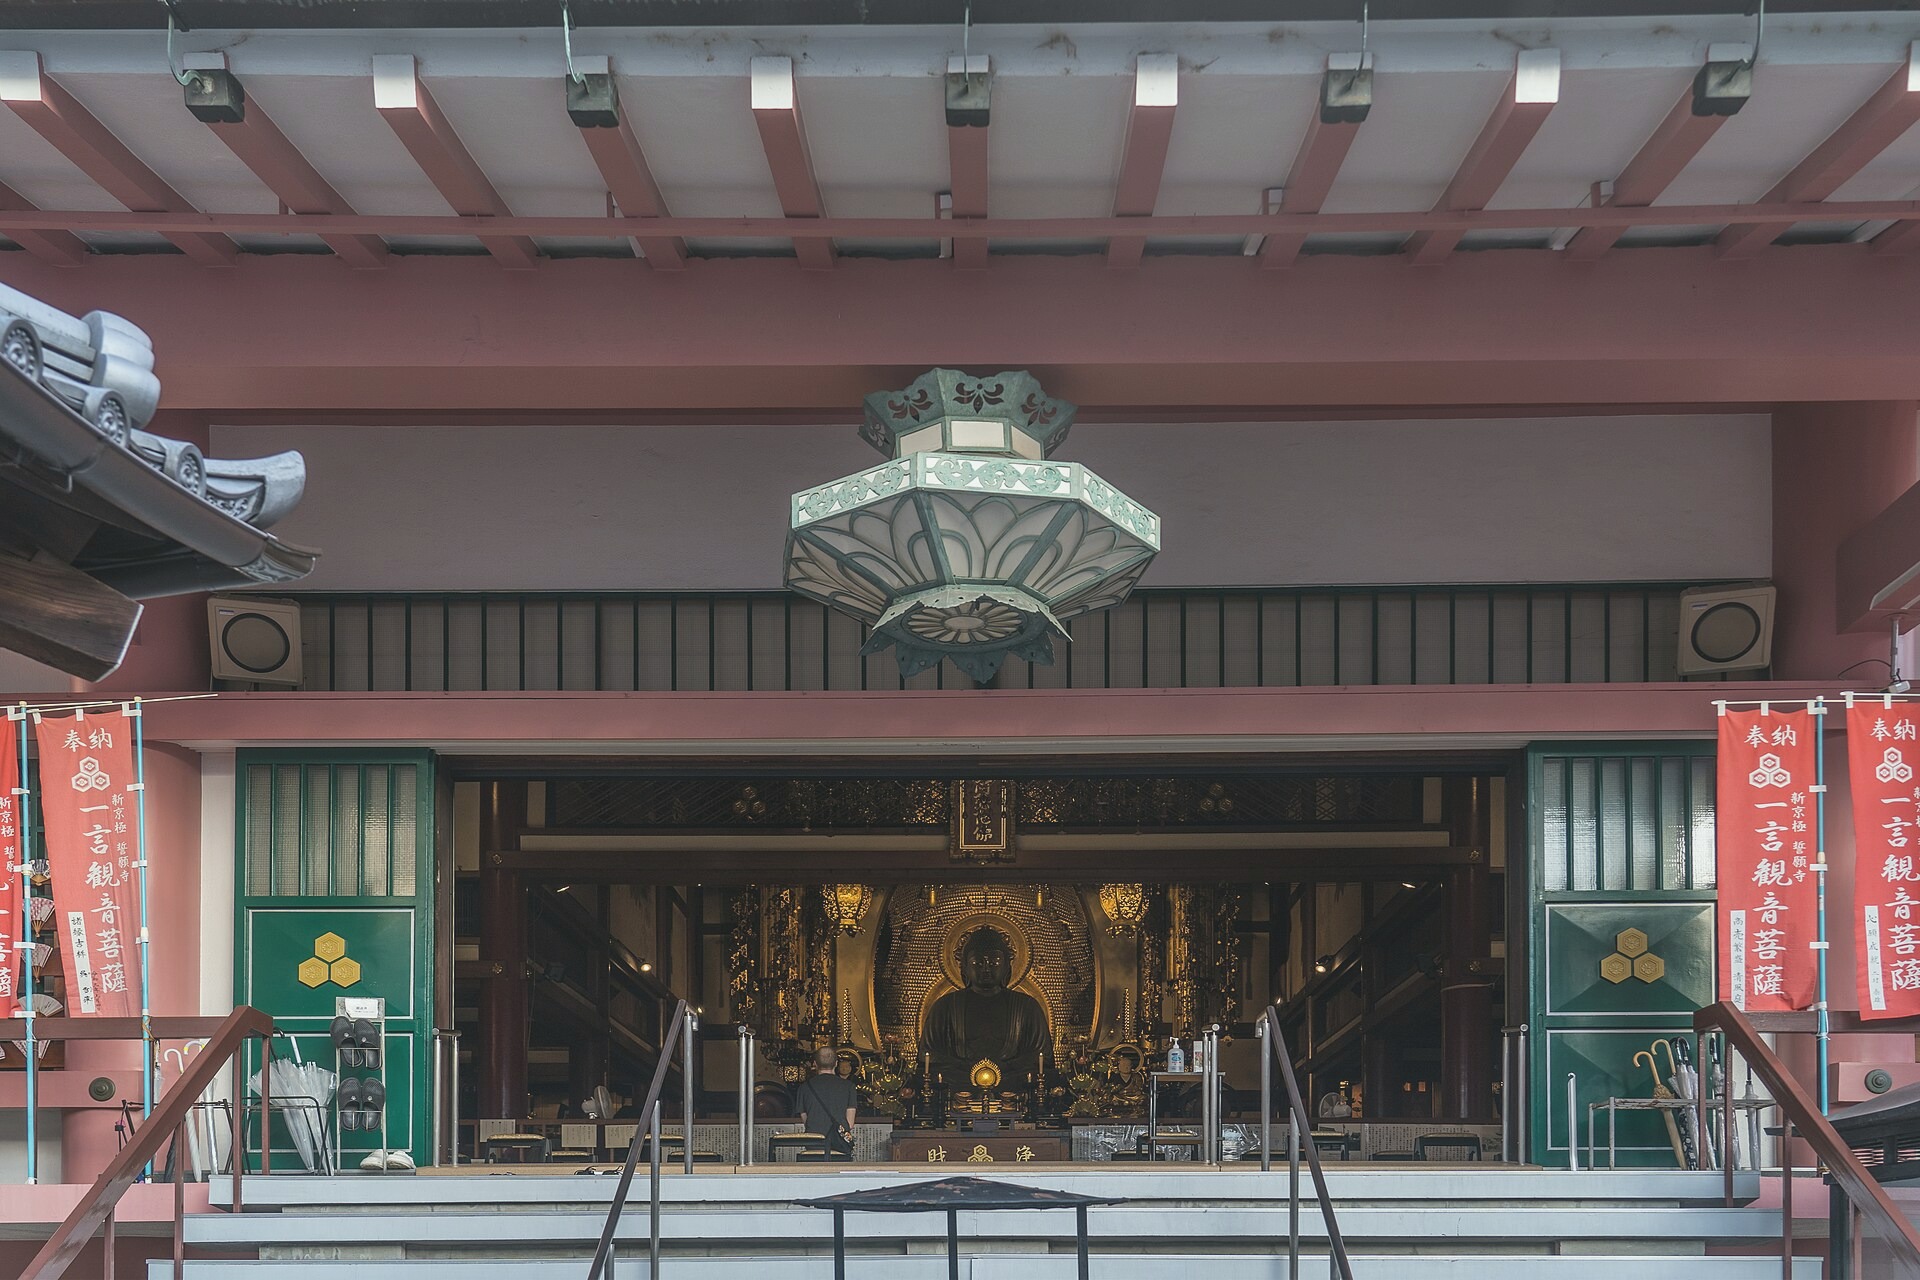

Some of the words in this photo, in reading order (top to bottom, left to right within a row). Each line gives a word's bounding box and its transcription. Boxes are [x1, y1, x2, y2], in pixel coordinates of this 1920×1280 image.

[62, 727, 113, 752] 奉納
[1744, 724, 1797, 748] 奉納
[1870, 717, 1916, 741] 奉納
[112, 793, 127, 834] 新京極
[1790, 792, 1807, 833] 新京極
[117, 842, 130, 882] 誓願寺
[1792, 841, 1807, 883] 誓願寺
[79, 804, 128, 994] 一言観音菩薩
[1751, 801, 1793, 996] 一言観音菩薩
[1880, 797, 1920, 991] 一言観音菩薩
